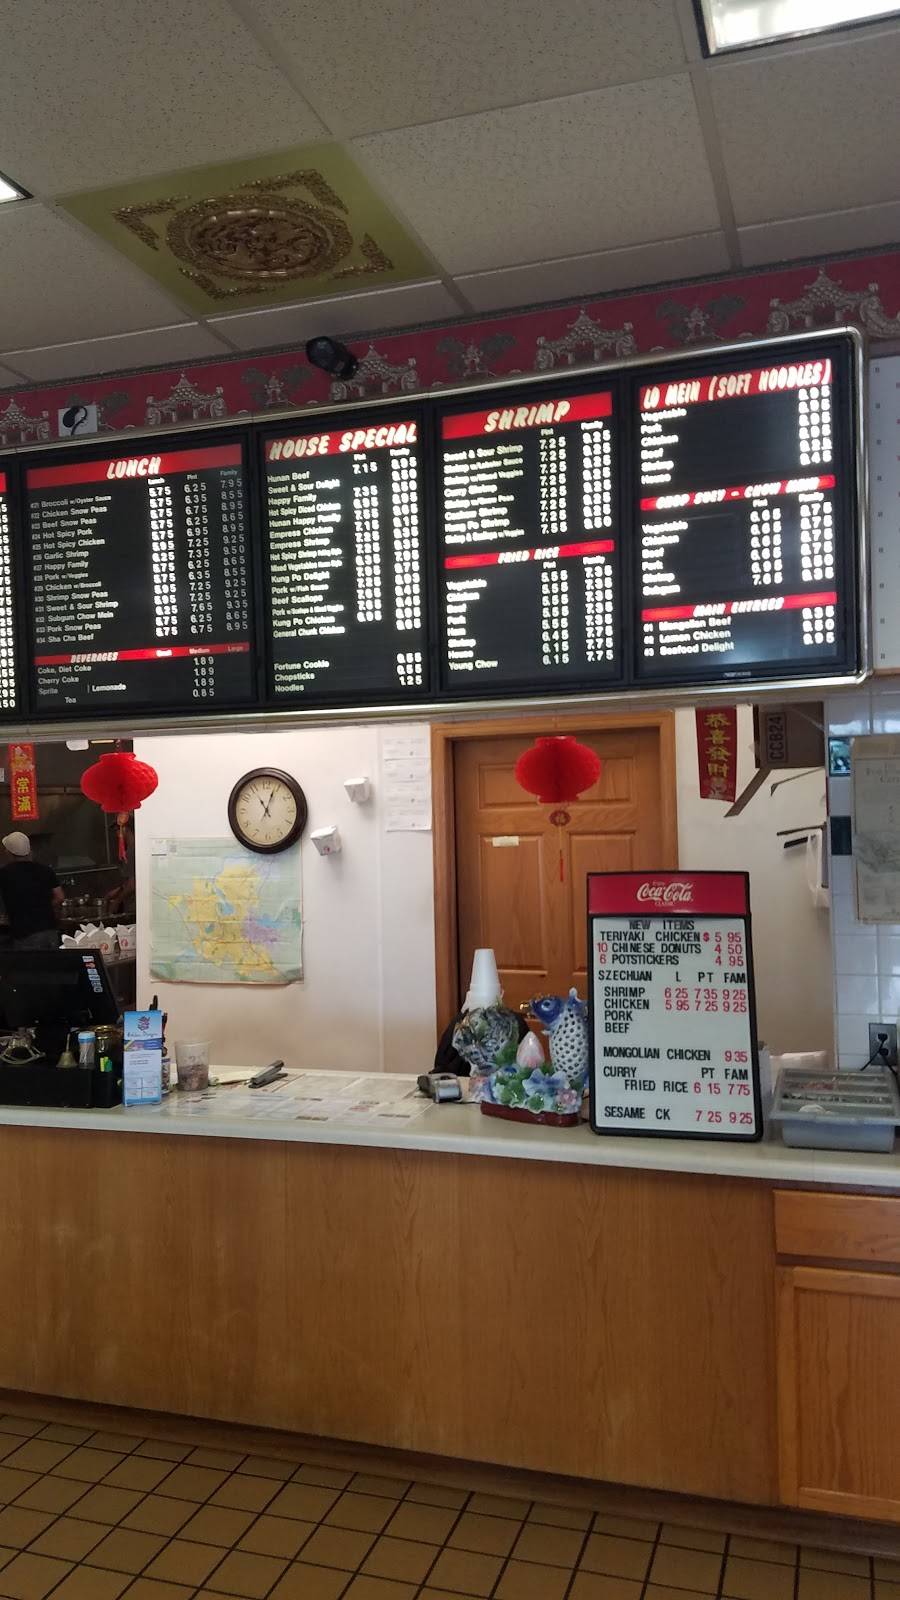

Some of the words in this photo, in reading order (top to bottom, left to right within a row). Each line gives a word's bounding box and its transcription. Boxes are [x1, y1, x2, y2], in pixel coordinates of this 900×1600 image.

[643, 388, 659, 409] LO
[665, 381, 700, 406] MEIN
[484, 400, 570, 432] SHRIMP
[269, 435, 330, 460] HOUSE
[339, 423, 416, 452] SPECIAL
[106, 456, 161, 480] LUNCH
[41, 499, 68, 508] Broccoli
[57, 530, 75, 538] Spicy
[57, 541, 76, 549] Spicy
[66, 550, 89, 558] Shrimp
[71, 652, 118, 663] BEVERAGES
[629, 920, 650, 930] NEW
[663, 920, 694, 930] ITEMS
[601, 932, 644, 942] TERIYAKI
[656, 932, 700, 942] CHICKEN
[597, 943, 607, 953] 10
[612, 943, 655, 953] CHINESE
[662, 944, 701, 954] DONUTS
[600, 954, 606, 964] 6
[612, 954, 679, 965] POTSTICKERS
[598, 971, 651, 981] SZECHUAN
[676, 972, 681, 981] L
[699, 972, 714, 982] PT
[724, 973, 746, 983] FAM
[604, 987, 645, 997] SHRIMP
[604, 999, 649, 1010] CHICKEN
[605, 1011, 633, 1021] PORK
[605, 1023, 629, 1033] BEEF
[604, 1047, 659, 1059] MONGOLIAN
[667, 1049, 710, 1061] CHICKEN
[604, 1067, 636, 1077] CURRY
[702, 1068, 714, 1079] PT
[725, 1069, 748, 1080] FAM
[625, 1080, 655, 1091] FRIED
[664, 1081, 688, 1092] RICE
[604, 1106, 645, 1118] SESAME
[656, 1109, 670, 1120] CK
